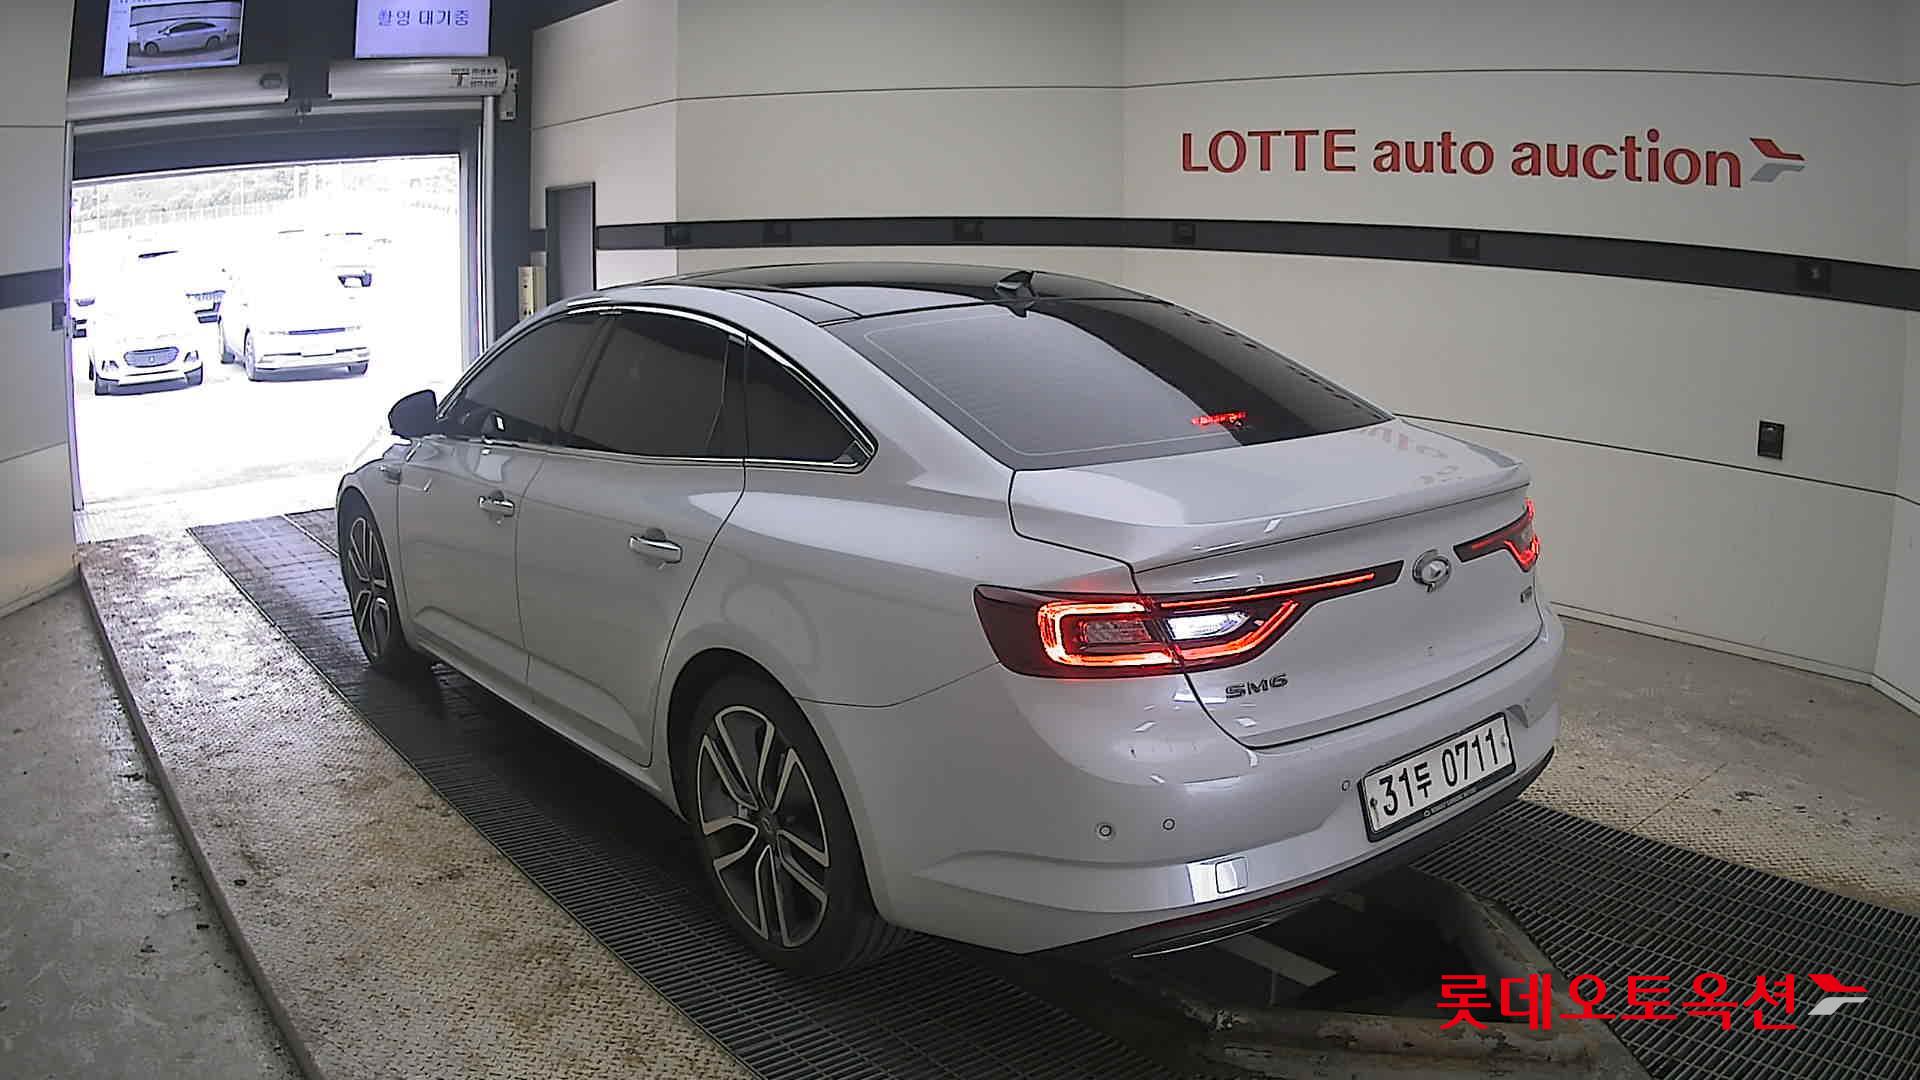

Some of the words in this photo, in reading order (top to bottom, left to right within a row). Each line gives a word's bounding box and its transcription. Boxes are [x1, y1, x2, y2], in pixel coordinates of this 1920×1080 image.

[418, 9, 470, 26] 대기중
[1182, 130, 1357, 173] LOTTE
[1373, 131, 1495, 176] auto
[1511, 128, 1742, 188] auction
[1226, 674, 1288, 698] SM6
[1379, 762, 1433, 816] 31두
[1441, 728, 1498, 787] 0711
